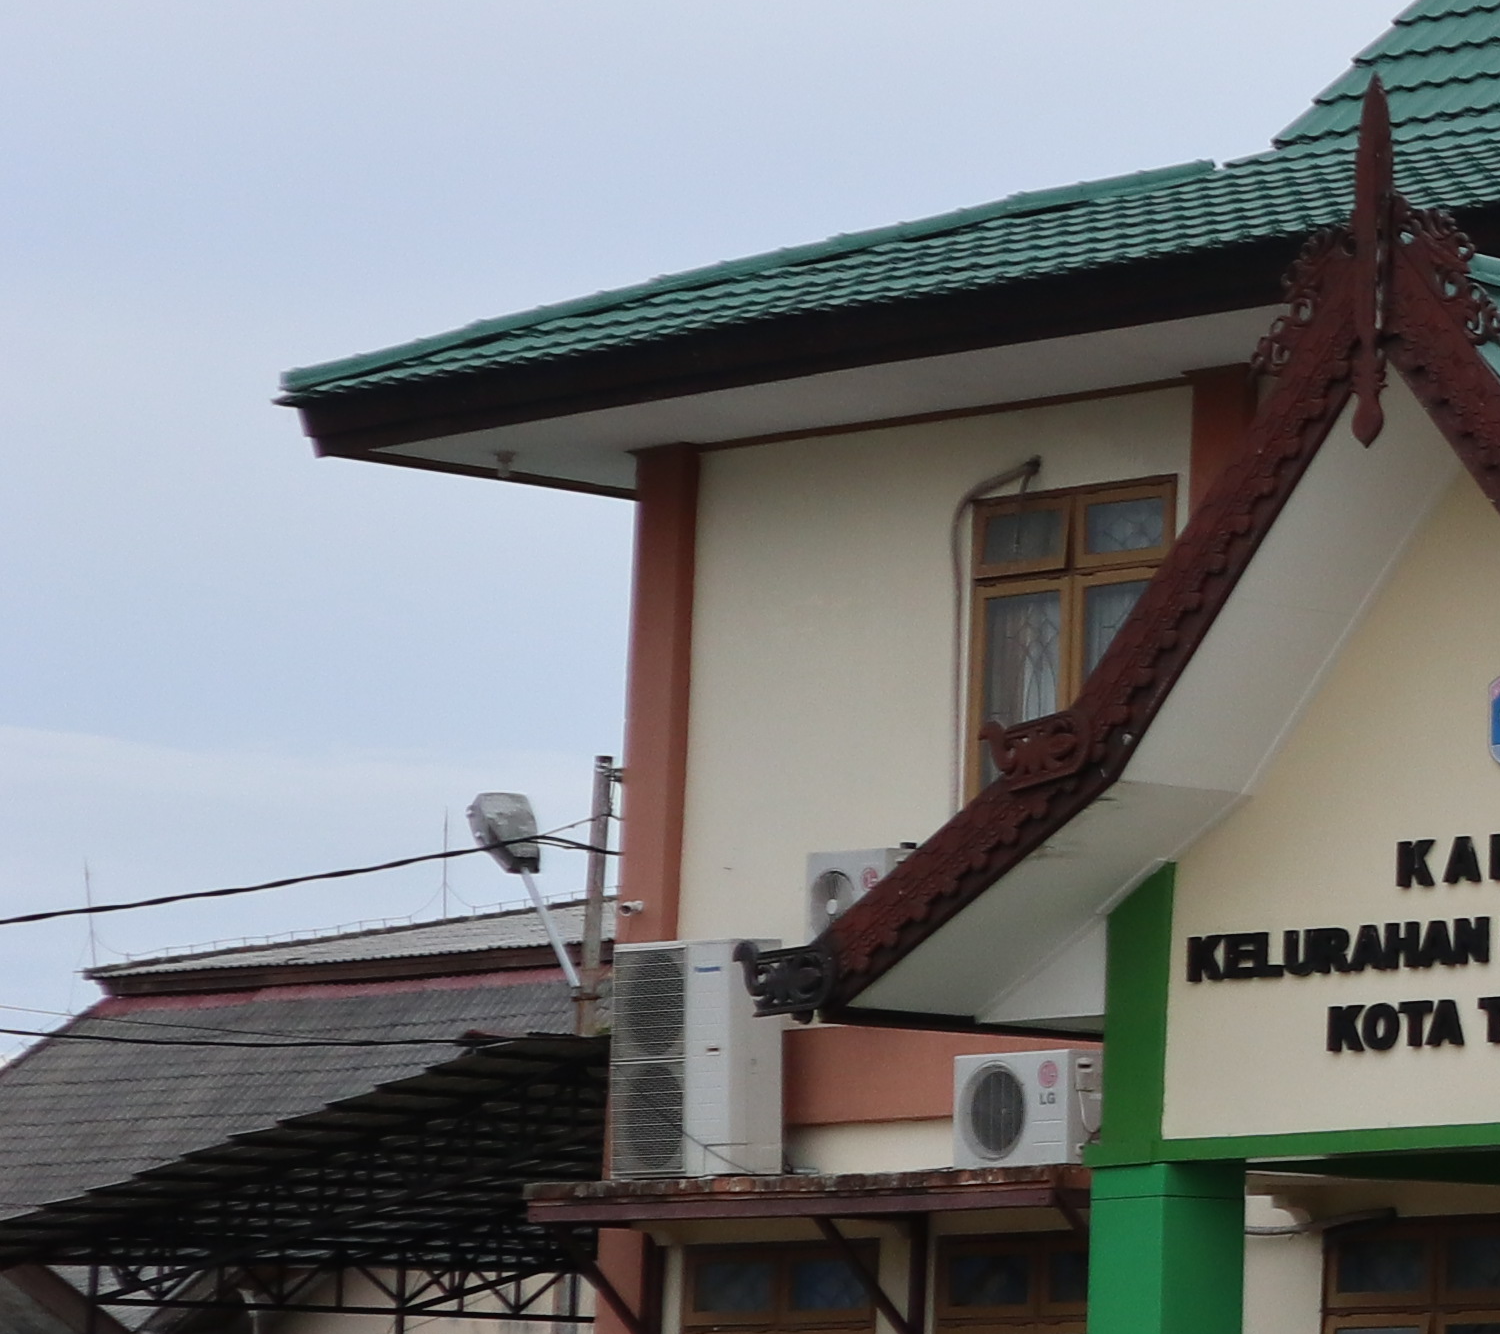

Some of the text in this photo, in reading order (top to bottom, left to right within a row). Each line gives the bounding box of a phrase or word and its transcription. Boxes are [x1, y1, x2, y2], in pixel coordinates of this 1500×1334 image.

[1186, 917, 1491, 985] KELURAHAN
[1326, 999, 1465, 1053] KOTA
[1039, 1092, 1056, 1105] LG
